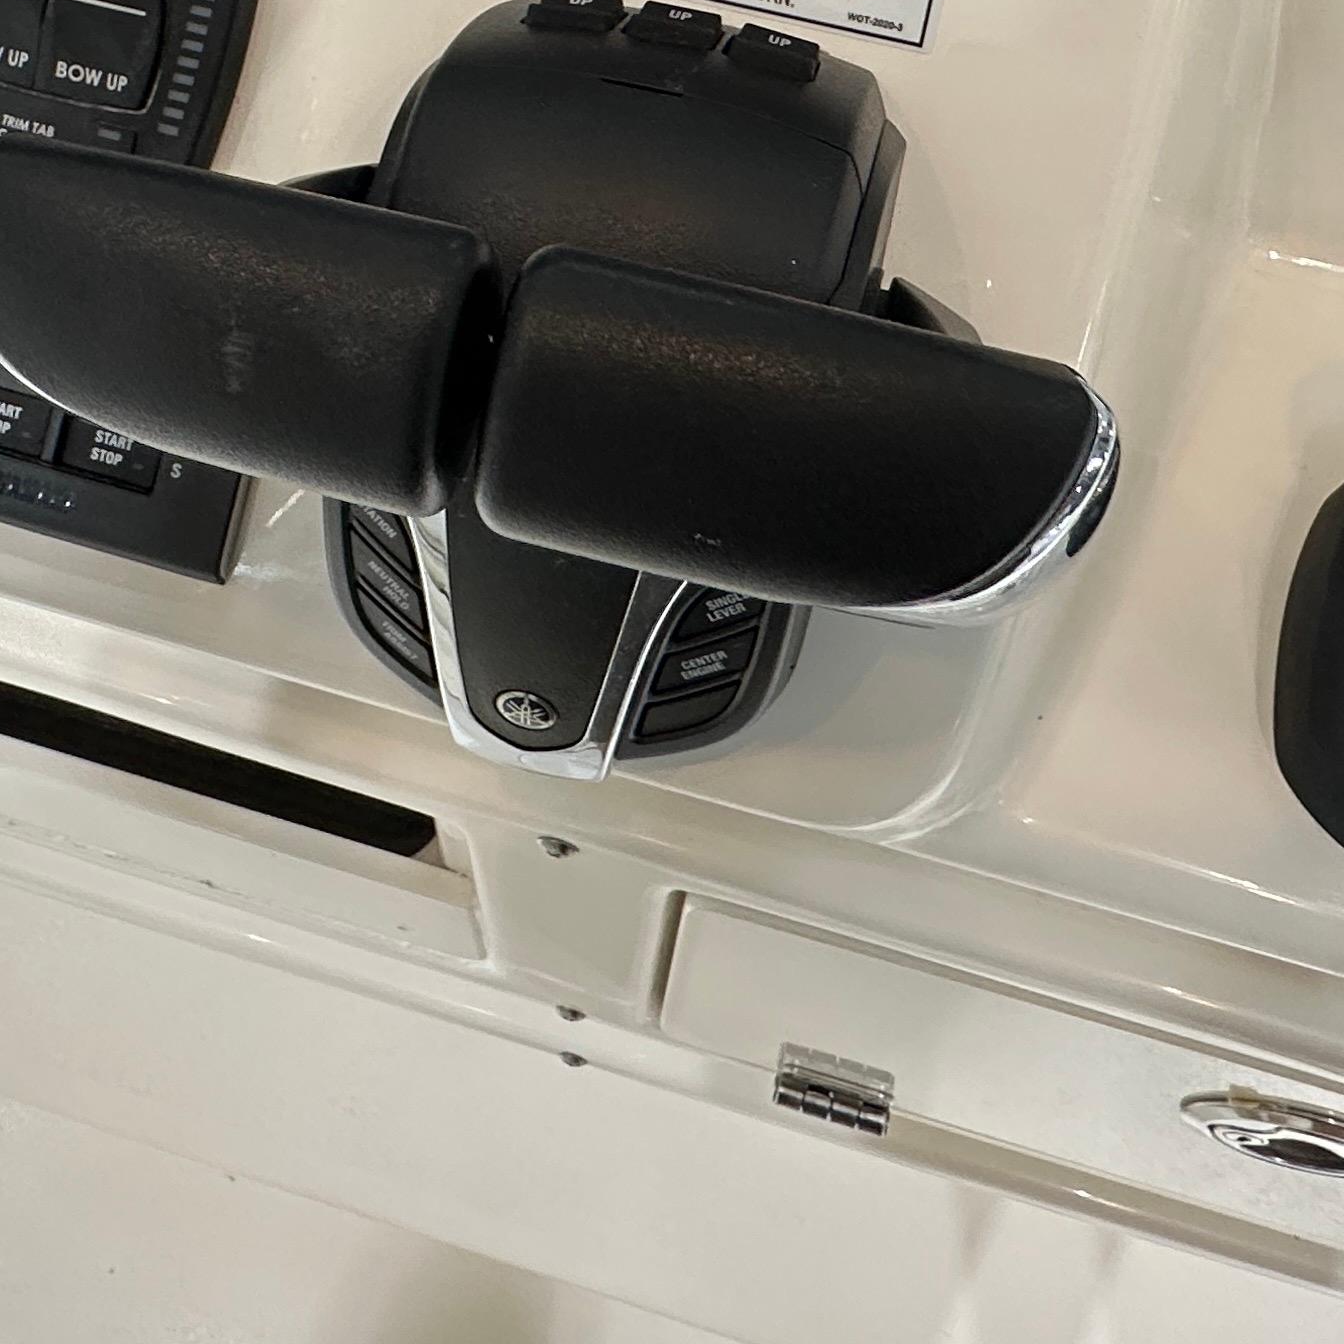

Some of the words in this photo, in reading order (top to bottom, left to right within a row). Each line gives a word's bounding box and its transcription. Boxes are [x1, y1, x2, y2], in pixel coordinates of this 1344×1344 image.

[668, 9, 693, 22] UP
[767, 34, 792, 48] UP
[7, 48, 30, 68] UP
[55, 61, 103, 87] BOW
[106, 72, 129, 93] UP
[1, 113, 29, 133] TRIM
[31, 121, 55, 138] TAB
[94, 429, 134, 451] START
[90, 447, 123, 466] STOP
[170, 463, 183, 479] S
[706, 602, 747, 623] LEVER
[680, 650, 728, 670] CENTER
